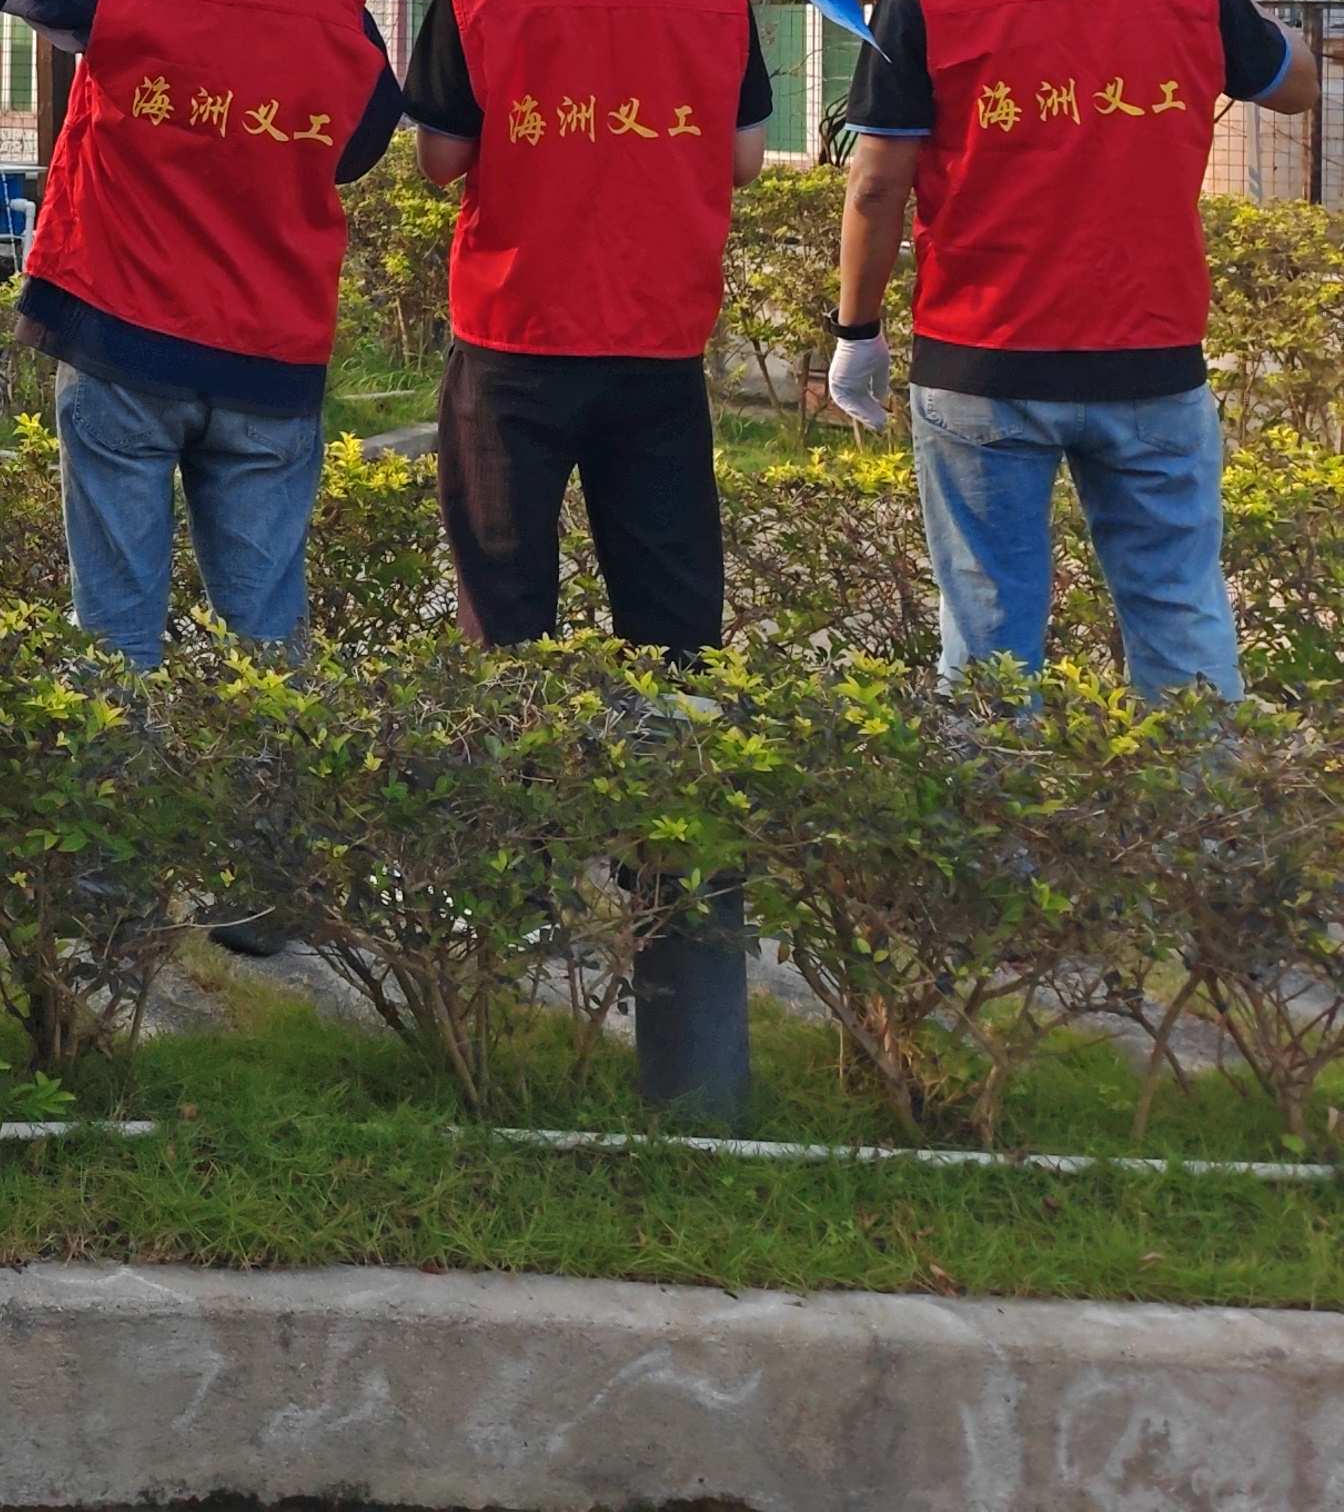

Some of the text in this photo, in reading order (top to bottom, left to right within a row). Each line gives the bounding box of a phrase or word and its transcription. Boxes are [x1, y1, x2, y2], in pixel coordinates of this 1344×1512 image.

[131, 76, 334, 147] 海洲义工
[509, 94, 702, 146] 海洲义工
[977, 76, 1187, 132] 海洲义工
